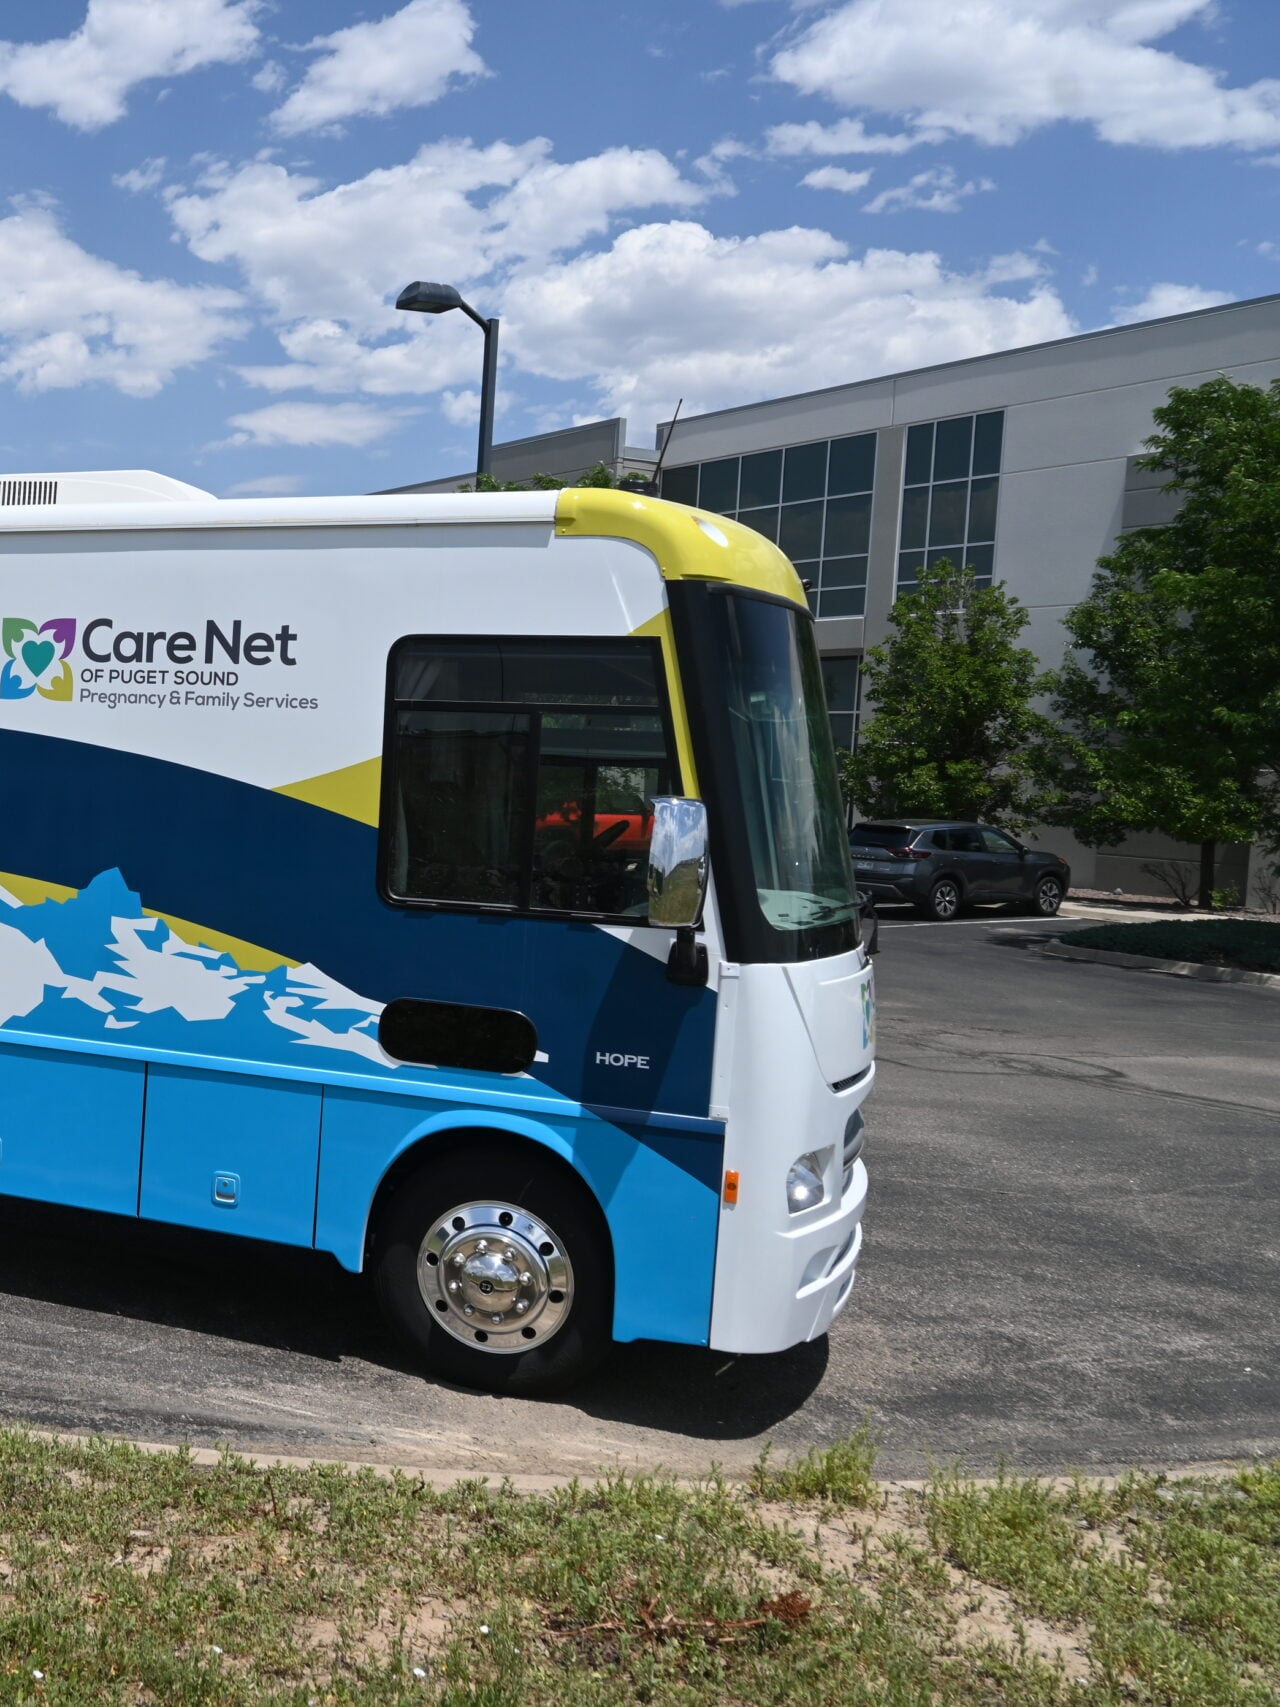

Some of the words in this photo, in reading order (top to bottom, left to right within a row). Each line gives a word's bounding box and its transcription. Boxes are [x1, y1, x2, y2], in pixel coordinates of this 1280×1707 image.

[82, 618, 197, 664] Care
[204, 619, 298, 667] Net
[80, 668, 104, 683] OF
[108, 669, 169, 685] PUGET
[173, 670, 239, 686] SOUND
[80, 688, 166, 709] Pregnancy
[169, 690, 181, 705] &
[184, 691, 240, 710] Family
[243, 692, 319, 709] Services
[595, 1051, 650, 1069] HOPE
